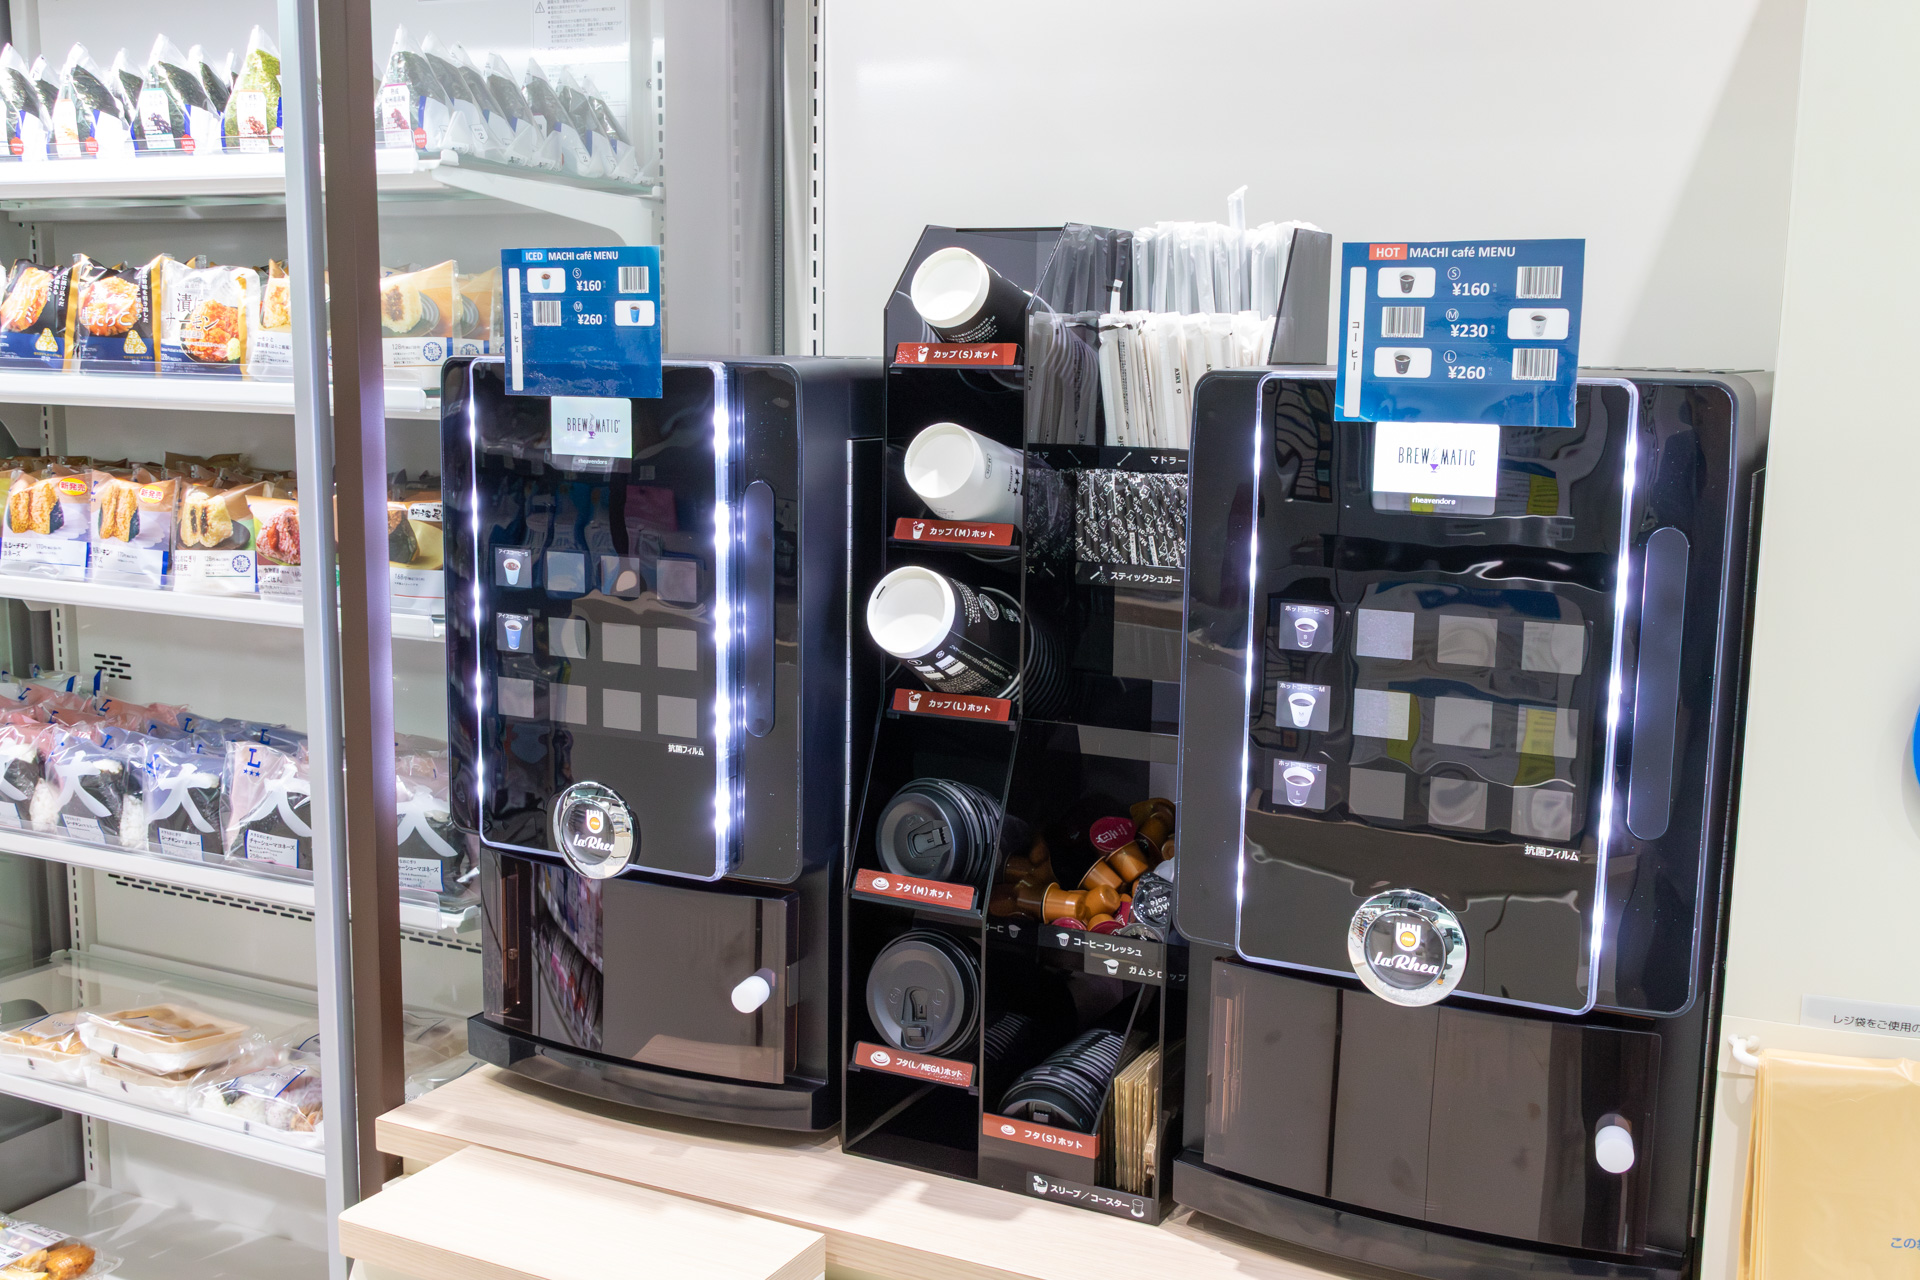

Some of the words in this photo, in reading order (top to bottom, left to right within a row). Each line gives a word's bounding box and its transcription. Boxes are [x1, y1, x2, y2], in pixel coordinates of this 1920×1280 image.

[525, 252, 543, 261] ICED
[548, 252, 575, 261] MACHI
[576, 251, 592, 261] café
[593, 251, 619, 260] MENU
[1375, 247, 1400, 258] HOT
[1409, 248, 1449, 258] MACHI
[1451, 247, 1475, 258] café
[1478, 247, 1516, 257] MENU
[576, 280, 602, 291] ¥160
[1452, 282, 1490, 296] ¥160
[577, 313, 602, 325] ¥260
[1450, 324, 1488, 338] ¥230
[1351, 321, 1360, 371] コーヒー
[932, 350, 999, 360] カップ(S)ホット
[1447, 366, 1486, 380] ¥260
[566, 417, 588, 432] BREW
[595, 419, 620, 434] MATIC
[1150, 455, 1187, 465] マドラー
[1398, 446, 1430, 464] BREW
[1440, 448, 1476, 466] MATIC
[60, 481, 86, 492] 新発売
[140, 490, 163, 500] 新発売
[929, 527, 996, 539] カップ(M)ホット
[1110, 571, 1181, 584] スティックシュガー
[1285, 604, 1330, 615] ホットコーヒーS
[928, 699, 991, 713] カップ(L)ホット
[668, 743, 705, 757] 抗菌フィルム
[247, 748, 261, 769] L
[1524, 844, 1580, 862] 抗菌フィルム
[895, 882, 953, 900] フタ(M)ホット
[1073, 938, 1143, 957] コーヒーフレッシュ
[1833, 1014, 1920, 1033] レジ袋をご使用の
[896, 1057, 963, 1078] フタ(L/MEGA)ホット
[1023, 1129, 1083, 1149] フタ(S)ホット
[1890, 1237, 1920, 1251] この
